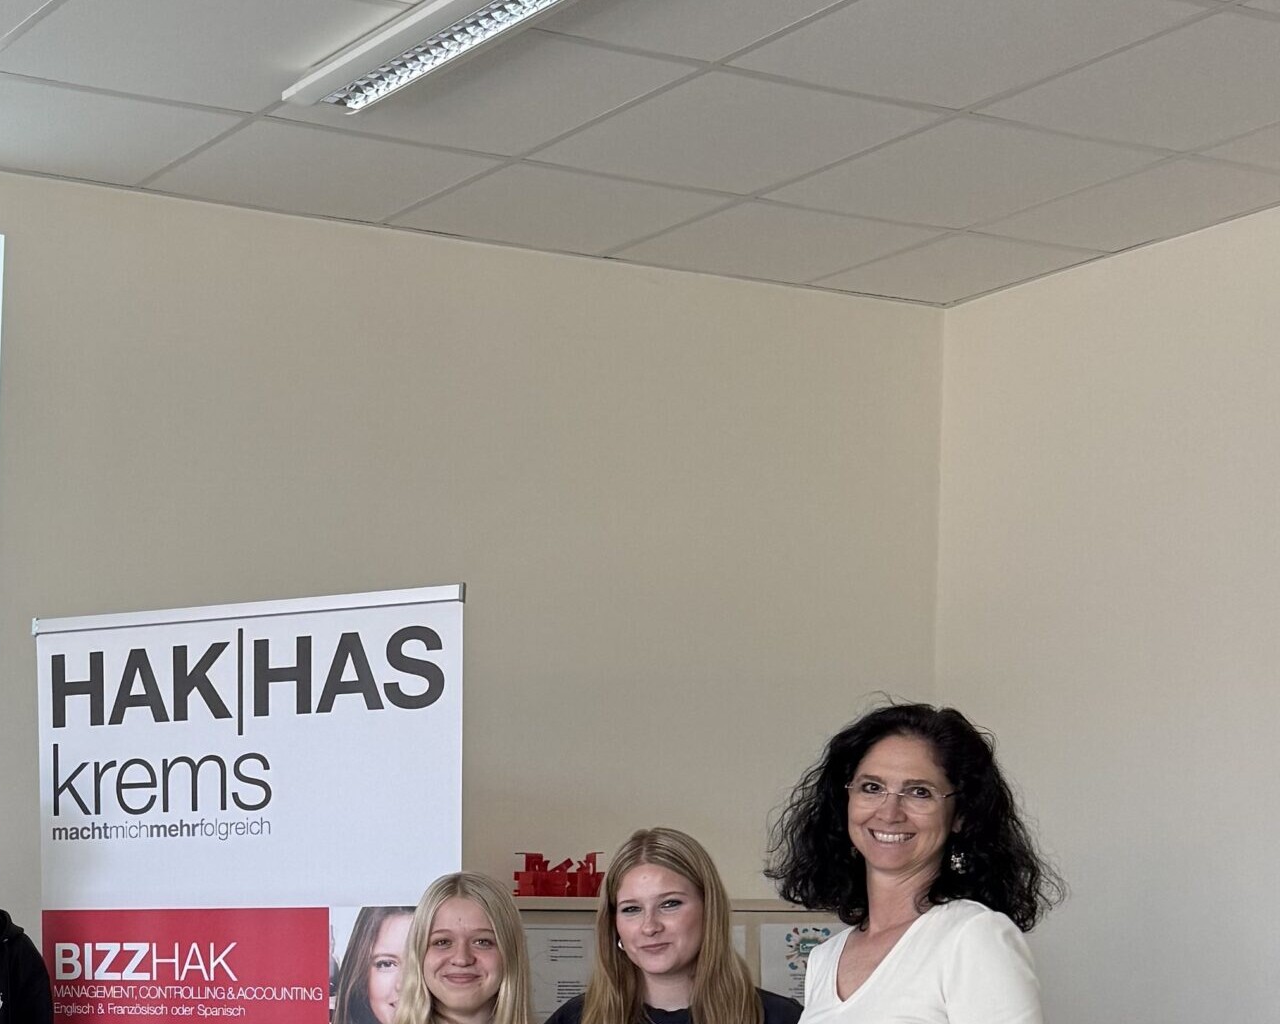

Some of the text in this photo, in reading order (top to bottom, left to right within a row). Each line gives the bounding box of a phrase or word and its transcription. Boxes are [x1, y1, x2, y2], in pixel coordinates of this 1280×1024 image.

[52, 743, 272, 816] krems
[52, 816, 271, 841] machtmichmehrfolgreich
[55, 942, 238, 981] BIZZHAK
[139, 986, 225, 1000] CONTROLLING
[227, 987, 236, 1000] &
[237, 987, 323, 1001] ACCOUNTING
[54, 1002, 246, 1019] Englisch & Französisch oder Spanisch
